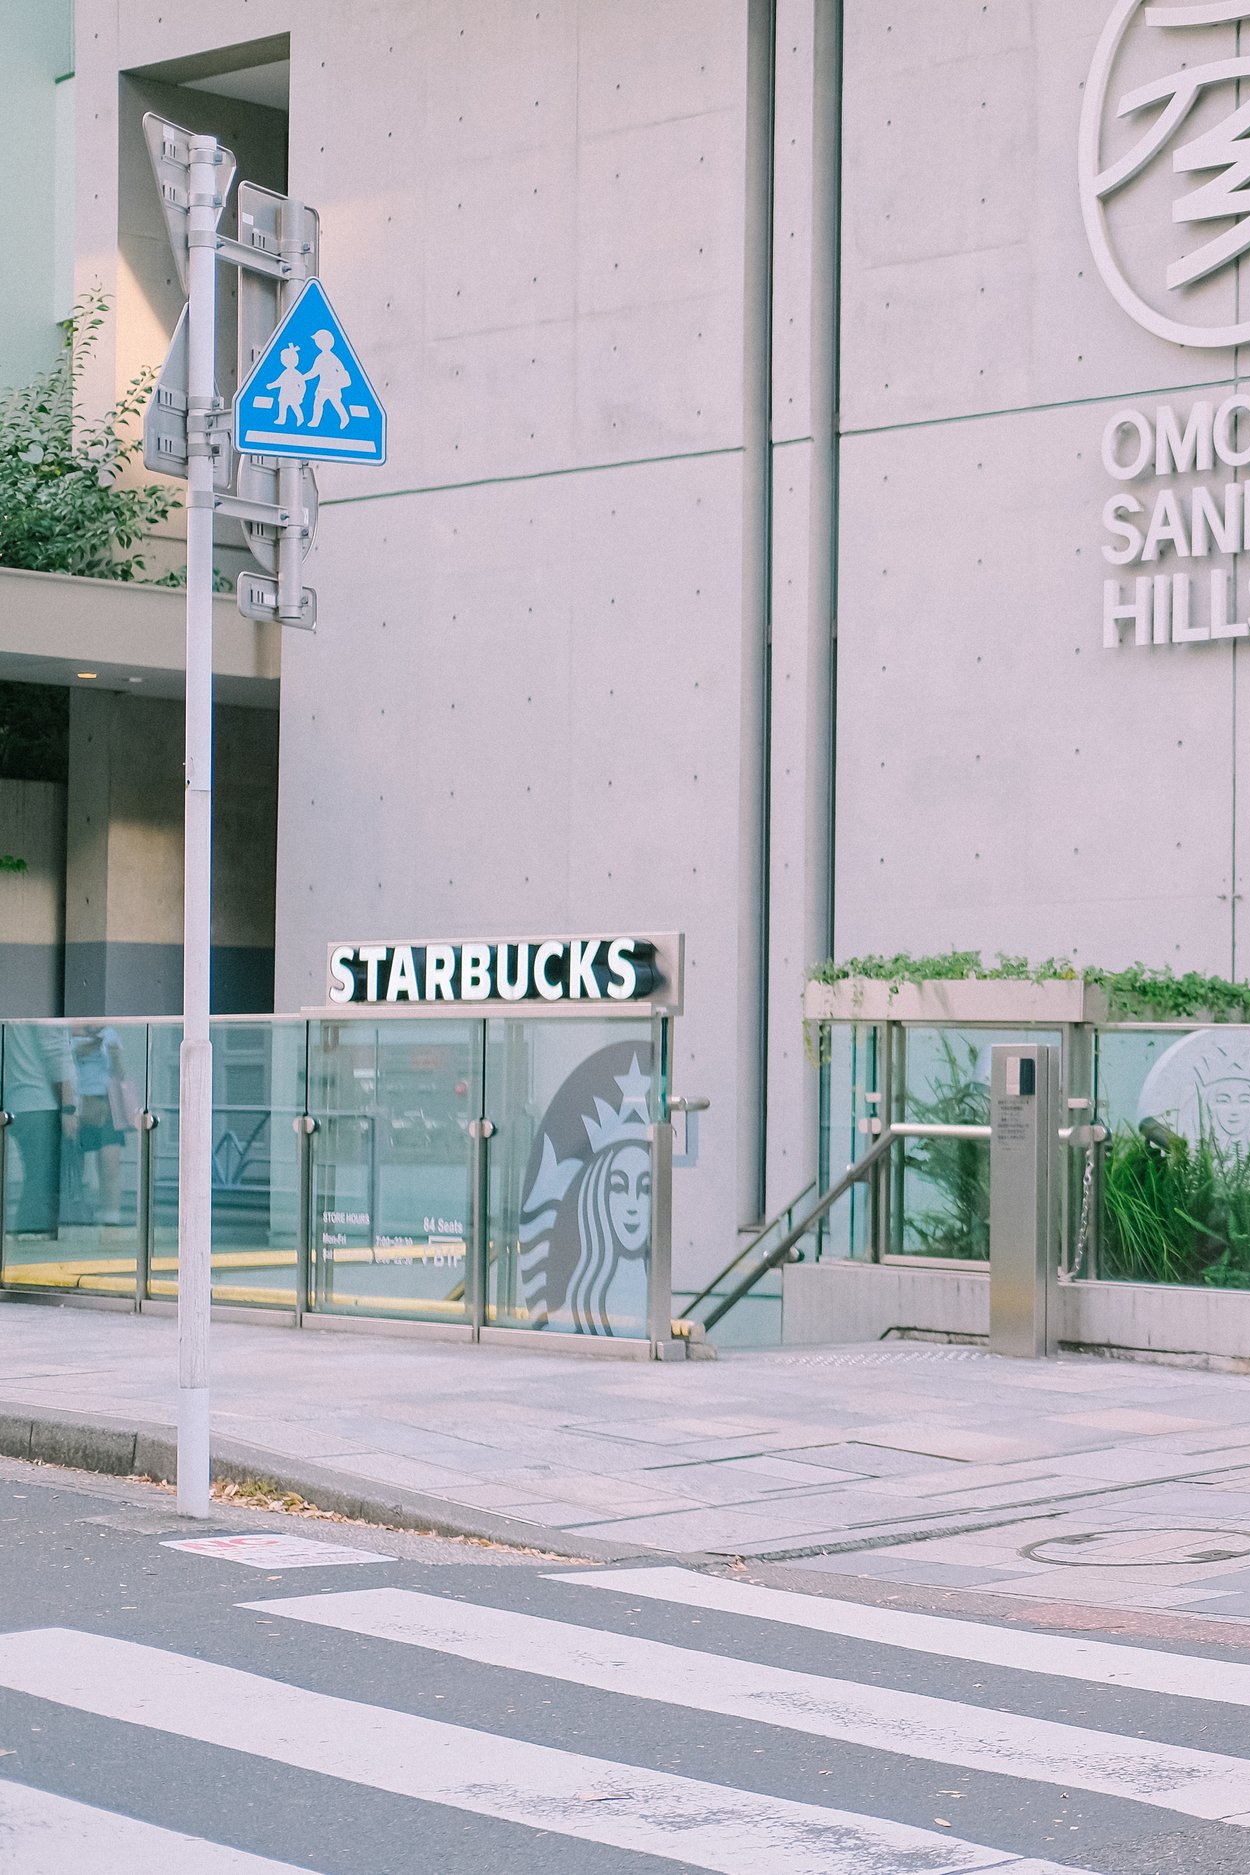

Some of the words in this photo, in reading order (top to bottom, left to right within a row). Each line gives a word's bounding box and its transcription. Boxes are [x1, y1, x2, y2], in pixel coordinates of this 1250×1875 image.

[329, 937, 637, 1003] STARBUCKS
[323, 1211, 345, 1224] STORE
[346, 1213, 370, 1225] HOURS
[424, 1216, 435, 1233] 84
[438, 1218, 464, 1234] Seats
